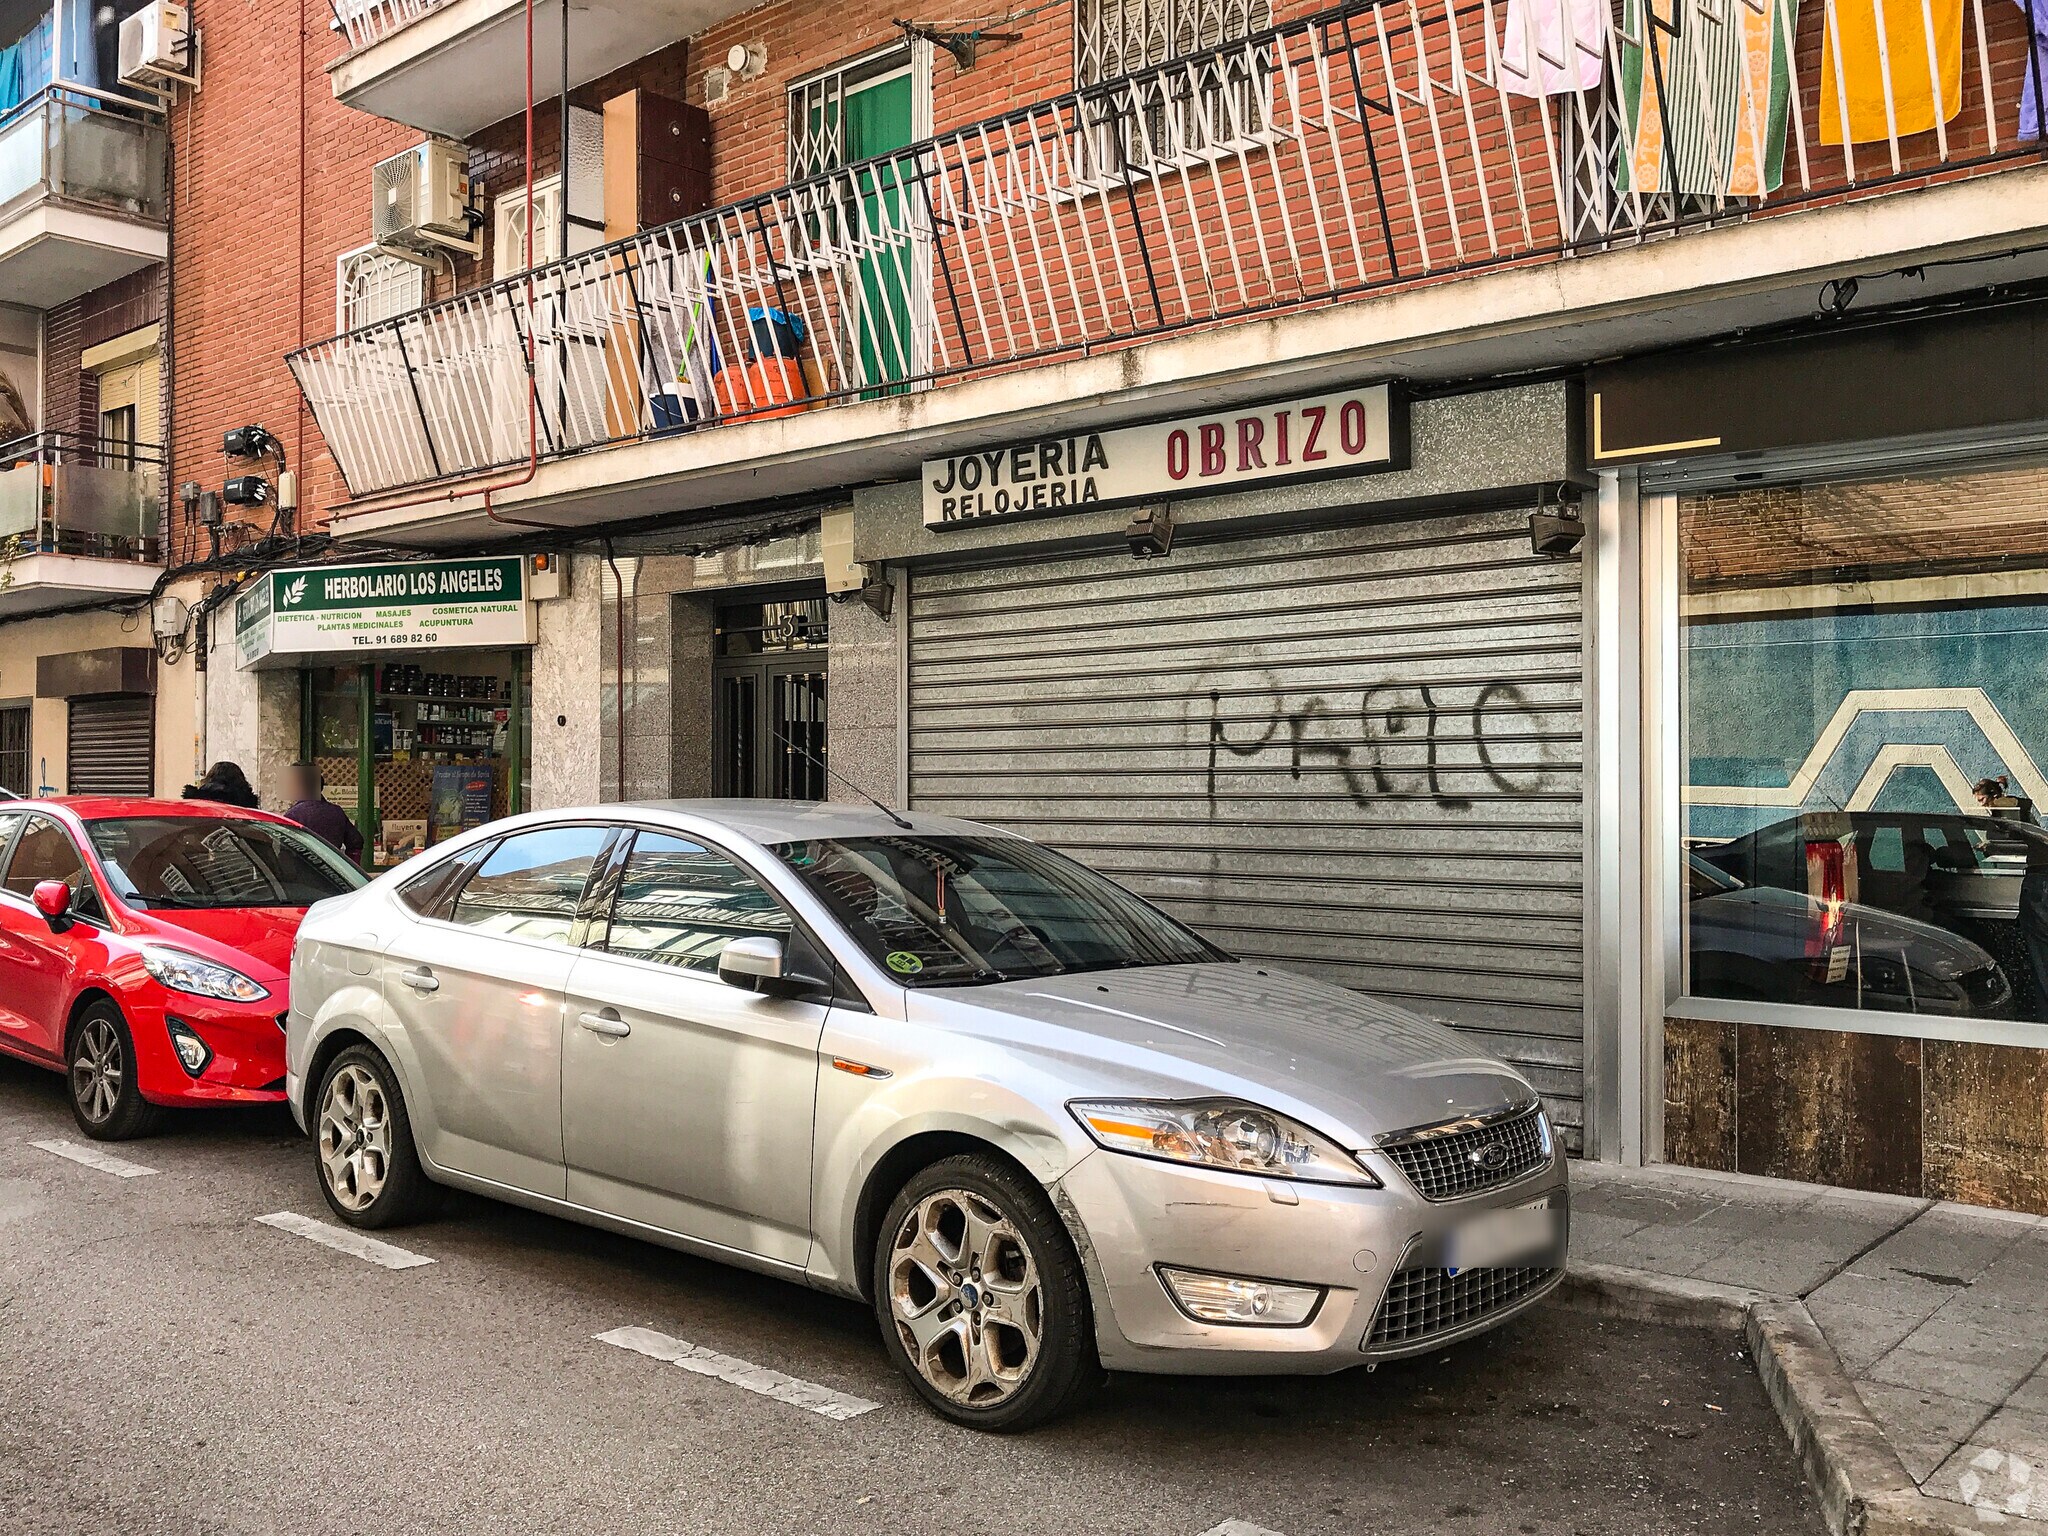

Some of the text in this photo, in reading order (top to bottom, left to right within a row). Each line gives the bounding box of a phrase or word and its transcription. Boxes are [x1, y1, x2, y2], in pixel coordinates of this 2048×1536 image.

[1165, 399, 1367, 481] OBRIZO
[932, 433, 1109, 495] JOYERIA
[942, 476, 1100, 522] RELOJERIA
[324, 568, 503, 600] HERBOLARIO LOS ANGELES
[277, 614, 315, 623] DIETETICA
[320, 612, 362, 621] NUTRICION
[375, 609, 412, 618] MASAJES
[432, 606, 479, 615] COSMETICA
[480, 604, 518, 613] NATURAL
[317, 618, 473, 631] PLANTAS MEDICINALES ACUPUNTURA
[782, 614, 794, 637] 3
[352, 633, 437, 645] TEL. 91 689 82 60
